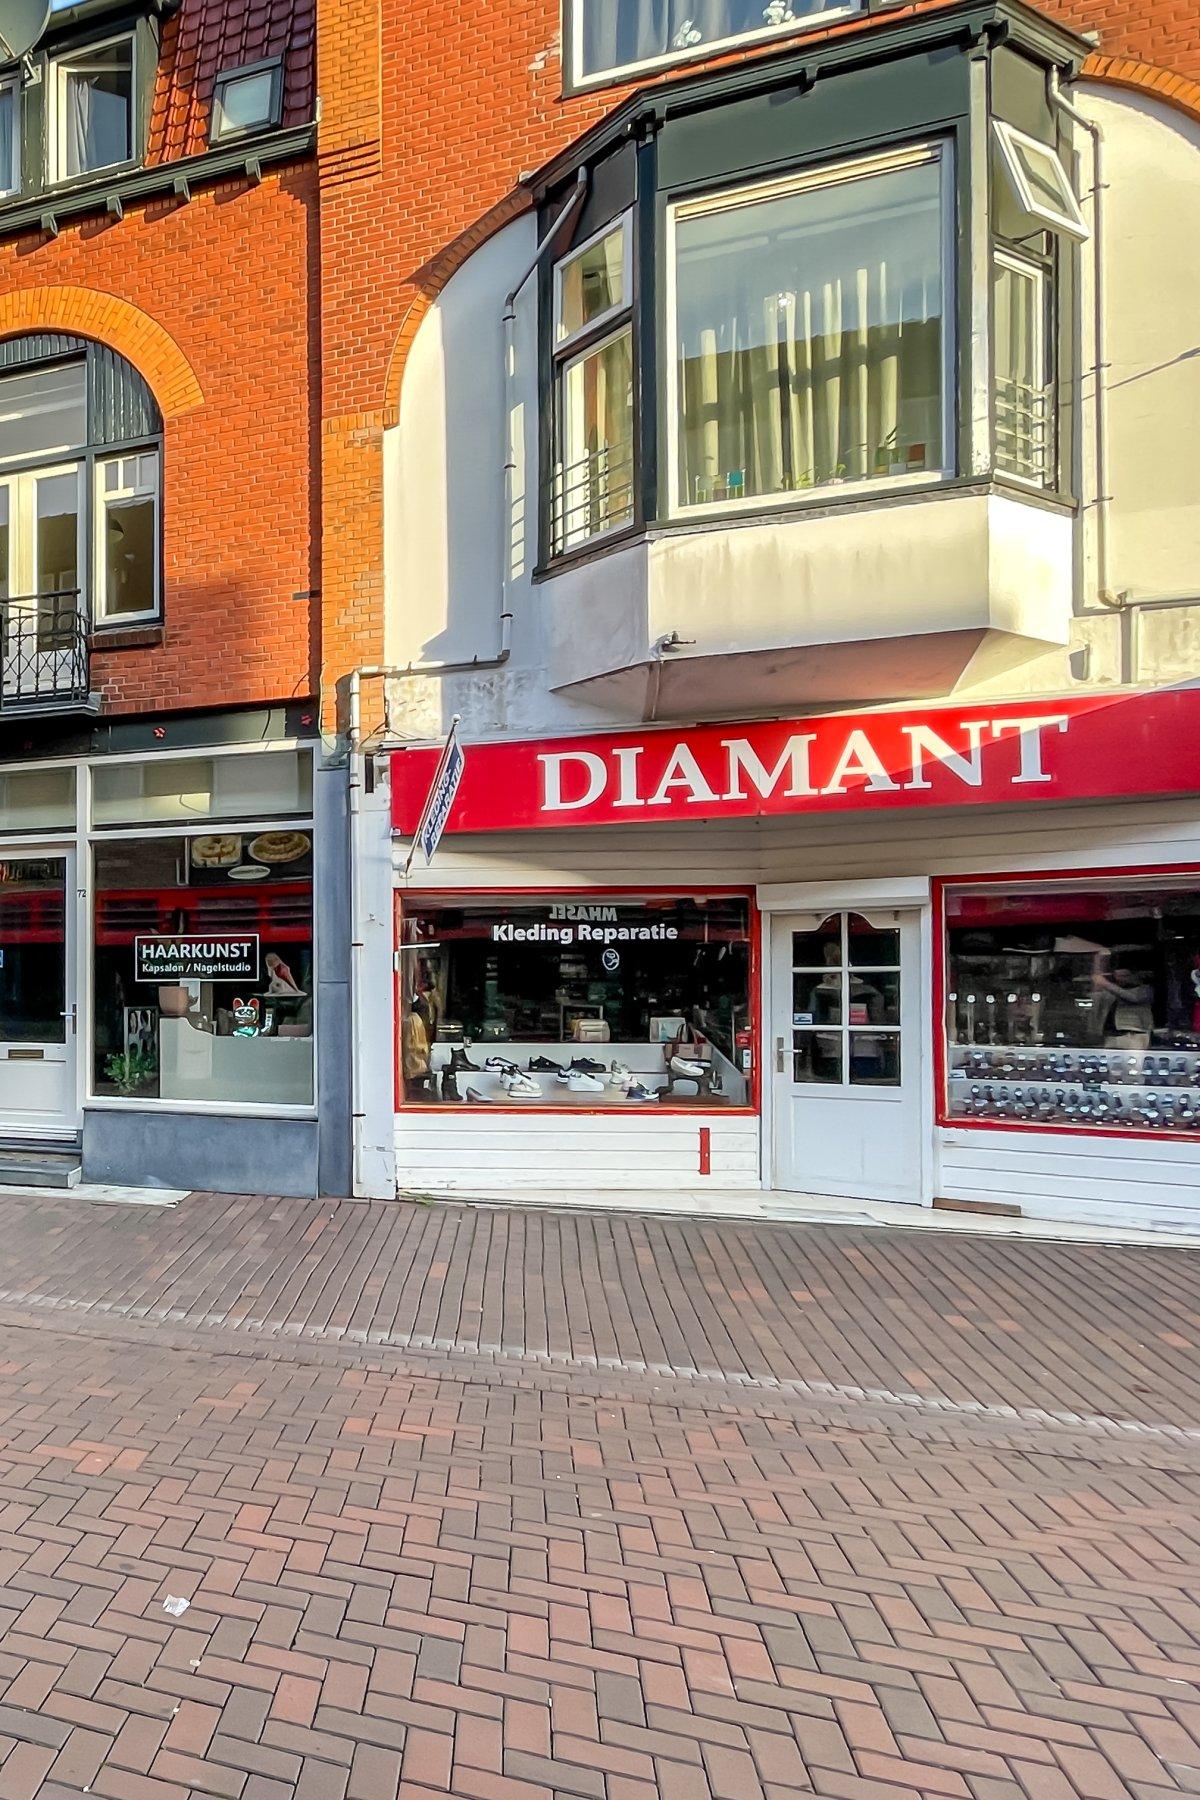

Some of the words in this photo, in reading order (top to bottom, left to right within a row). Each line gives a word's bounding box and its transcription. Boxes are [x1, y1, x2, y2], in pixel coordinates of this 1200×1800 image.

[536, 714, 1069, 811] DIAMANT
[77, 888, 87, 898] 72
[493, 923, 573, 944] Kleding
[578, 923, 678, 944] Reparatie
[142, 942, 252, 959] HAARKUNST
[142, 963, 184, 974] Kapsalon
[193, 961, 251, 974] Nagelstudio
